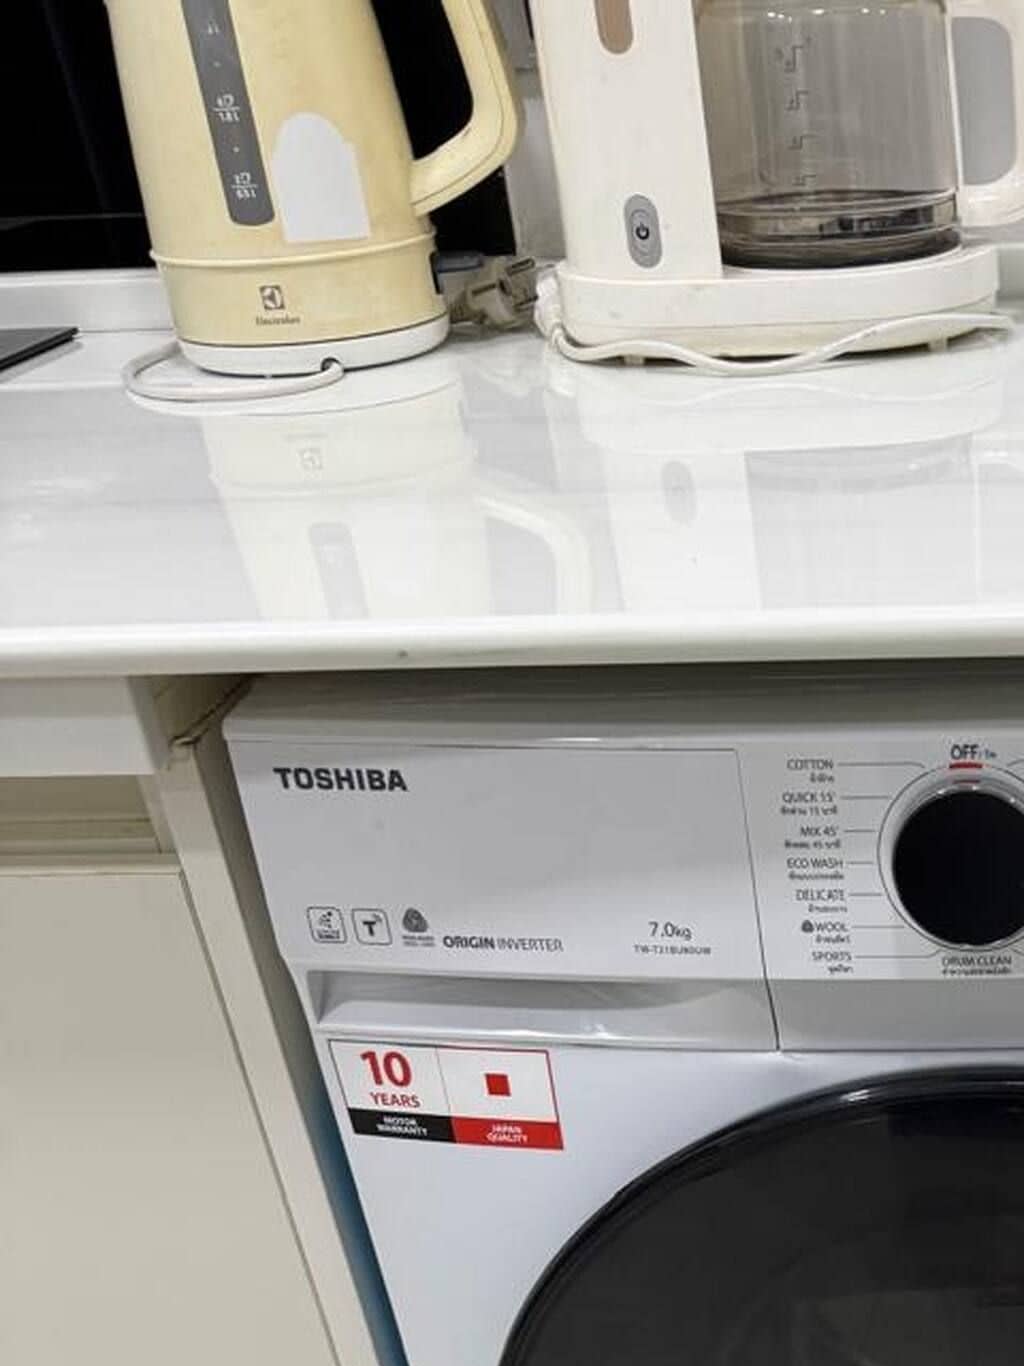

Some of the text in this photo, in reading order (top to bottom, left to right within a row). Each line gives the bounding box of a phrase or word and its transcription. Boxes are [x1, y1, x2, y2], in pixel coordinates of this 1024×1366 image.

[950, 744, 979, 760] OFF
[786, 759, 834, 770] COTTON
[273, 768, 408, 792] TOSHIBA
[782, 792, 817, 803] QUICK
[800, 825, 823, 837] MIX
[786, 857, 844, 869] ECO WASH
[795, 889, 845, 902] DELICATE
[647, 921, 692, 941] 7.0kg
[815, 921, 849, 933] WOOL
[442, 935, 565, 953] ORIGIN INVERTER
[811, 950, 853, 963] SPORTS
[977, 955, 1013, 966] CLEAN
[360, 1050, 412, 1088] 10
[370, 1091, 422, 1109] YEARS
[383, 1117, 418, 1126] MOTOR
[376, 1124, 429, 1136] WARRANTY
[491, 1123, 523, 1134] JAPAN
[486, 1133, 529, 1144] QUALITY
